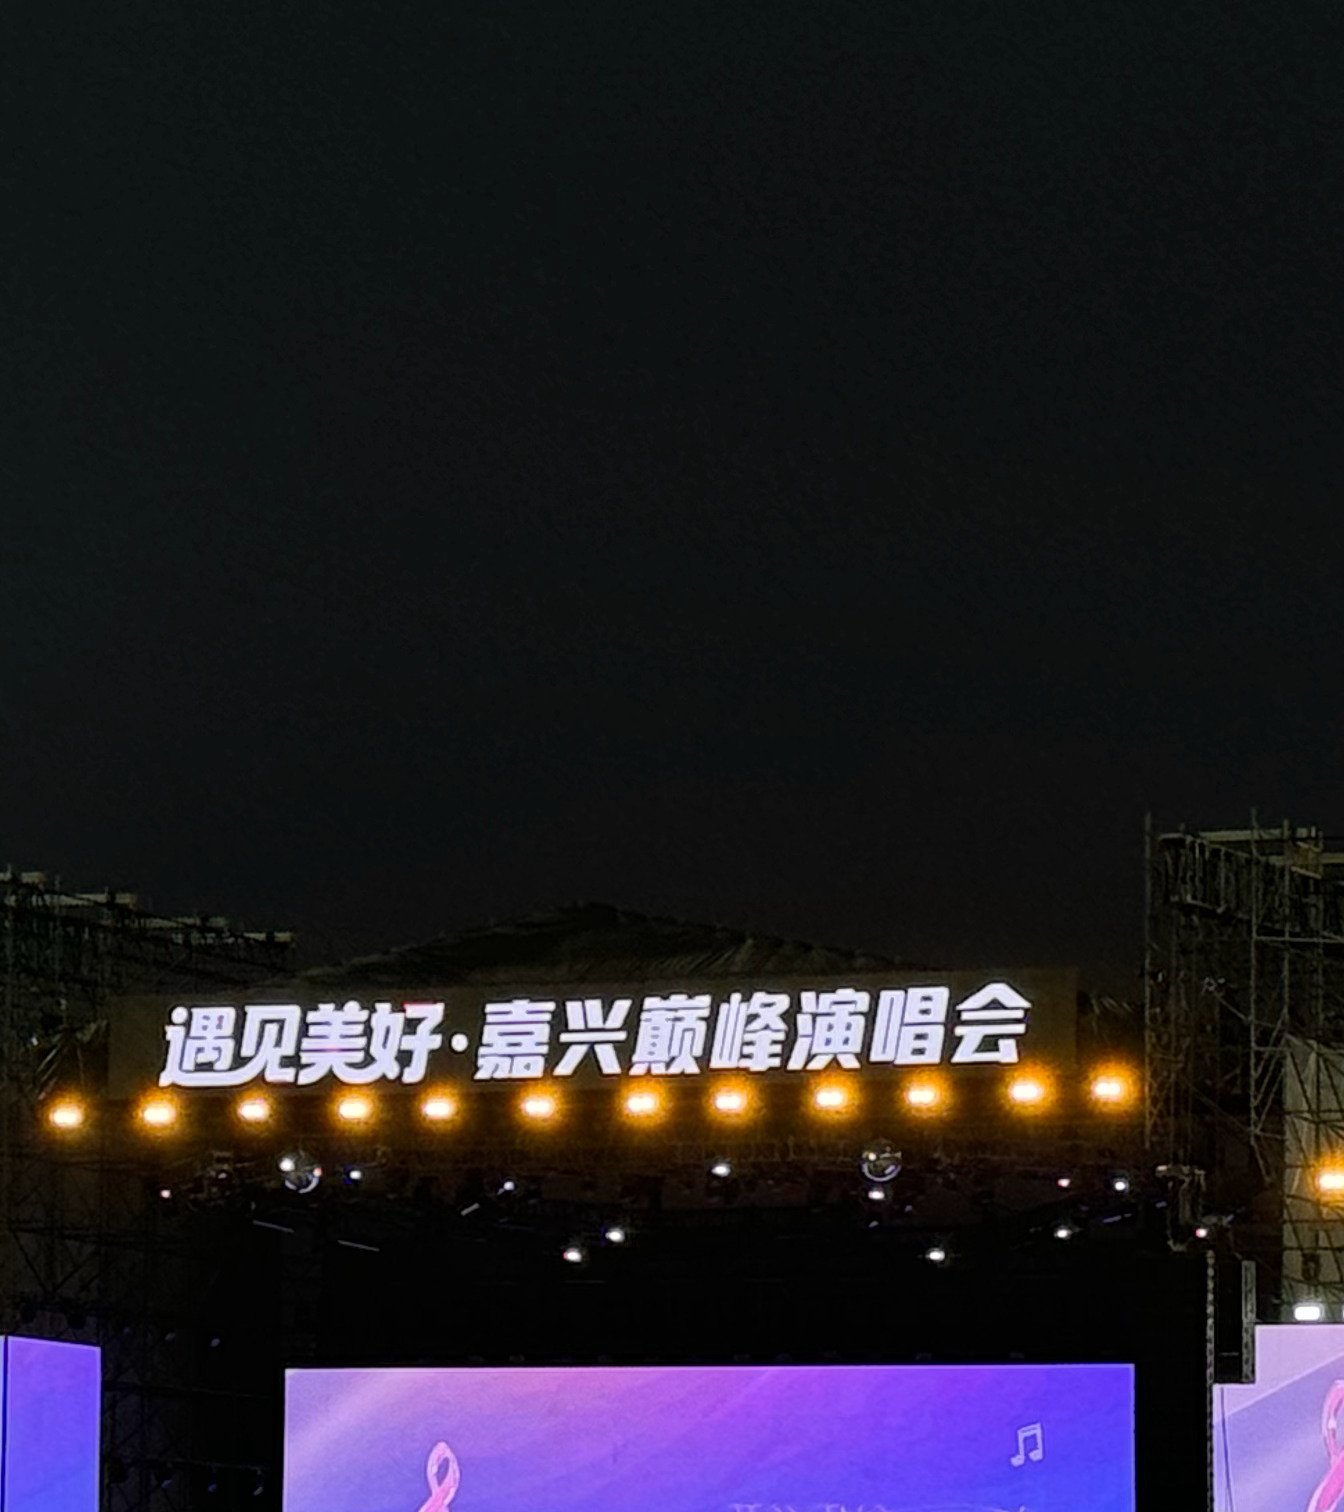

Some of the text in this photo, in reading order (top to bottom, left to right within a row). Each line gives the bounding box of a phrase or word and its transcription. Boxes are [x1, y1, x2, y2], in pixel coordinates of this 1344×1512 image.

[158, 981, 1032, 1088] 遇见美好·嘉兴巅峰演唱会
